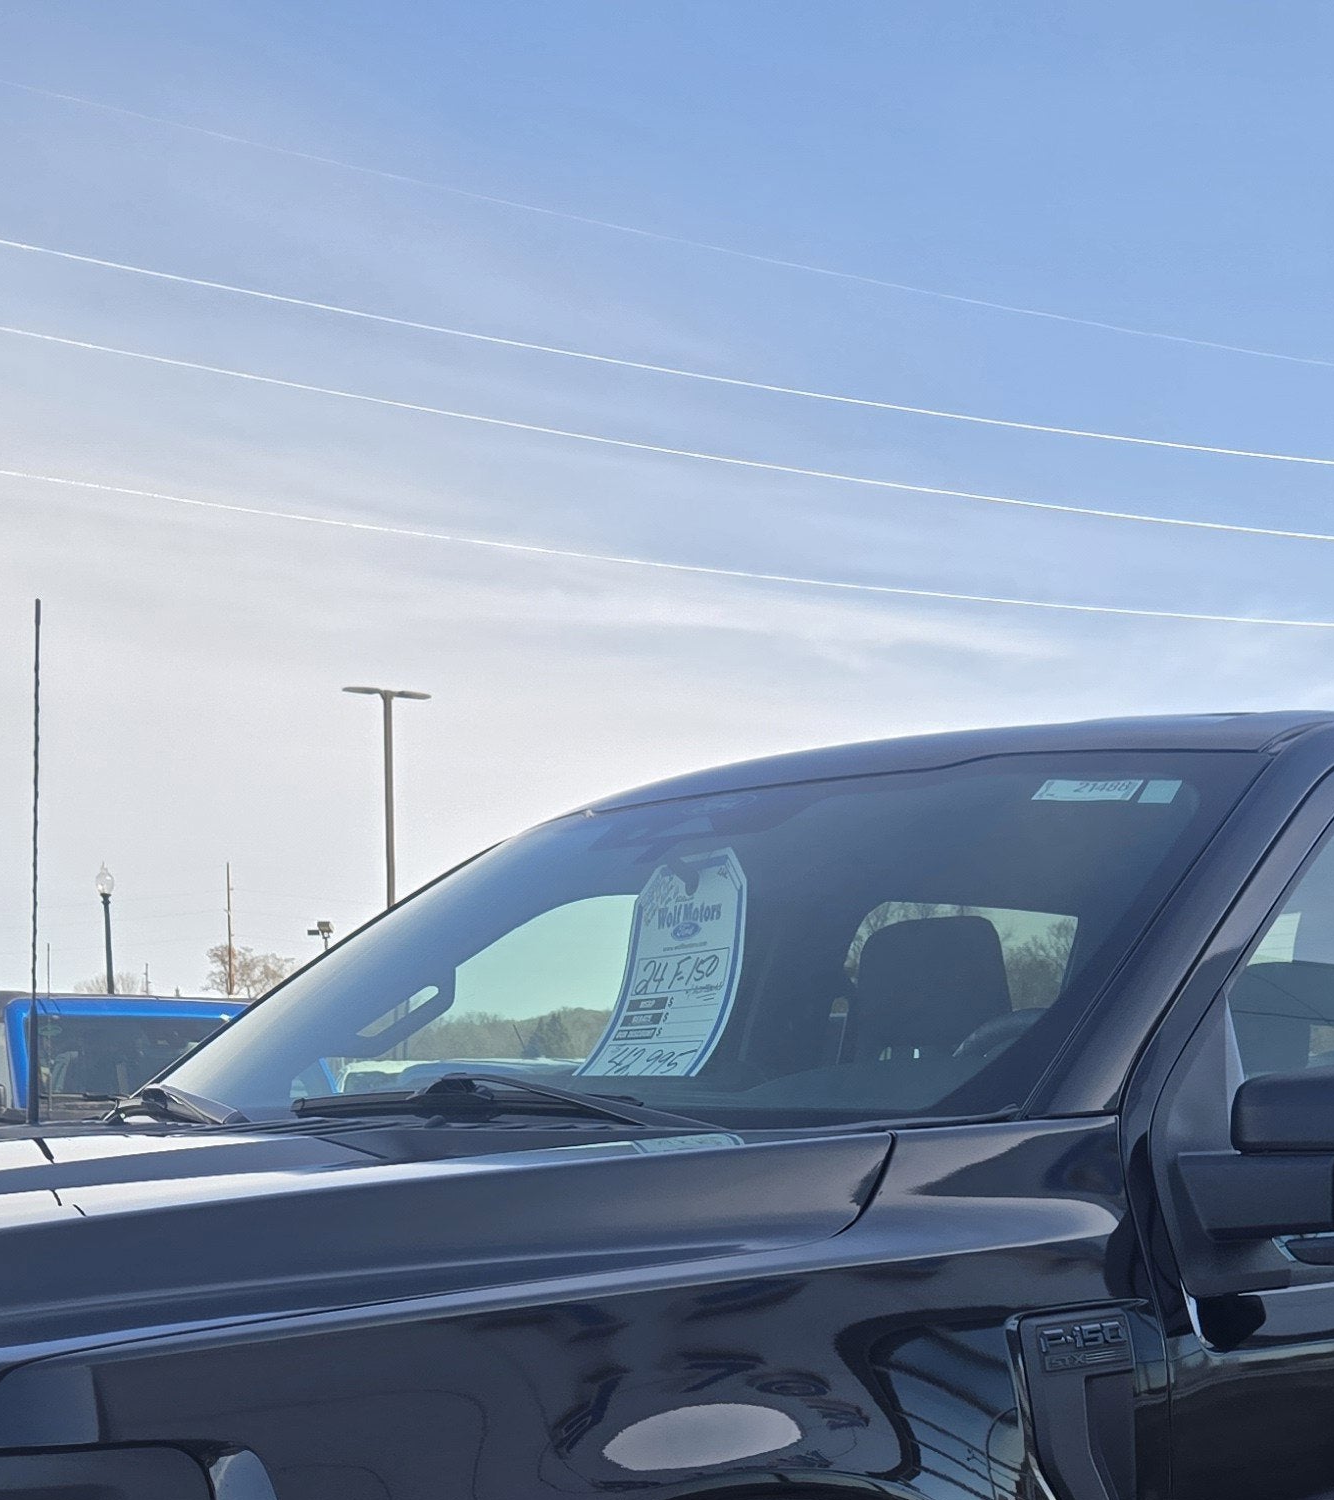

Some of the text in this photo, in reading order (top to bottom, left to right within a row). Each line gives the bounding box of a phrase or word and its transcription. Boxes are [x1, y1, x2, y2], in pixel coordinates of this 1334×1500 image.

[658, 902, 722, 930] Wolf Motors
[635, 954, 720, 995] 24 F-150
[1040, 1321, 1125, 1353] F-150
